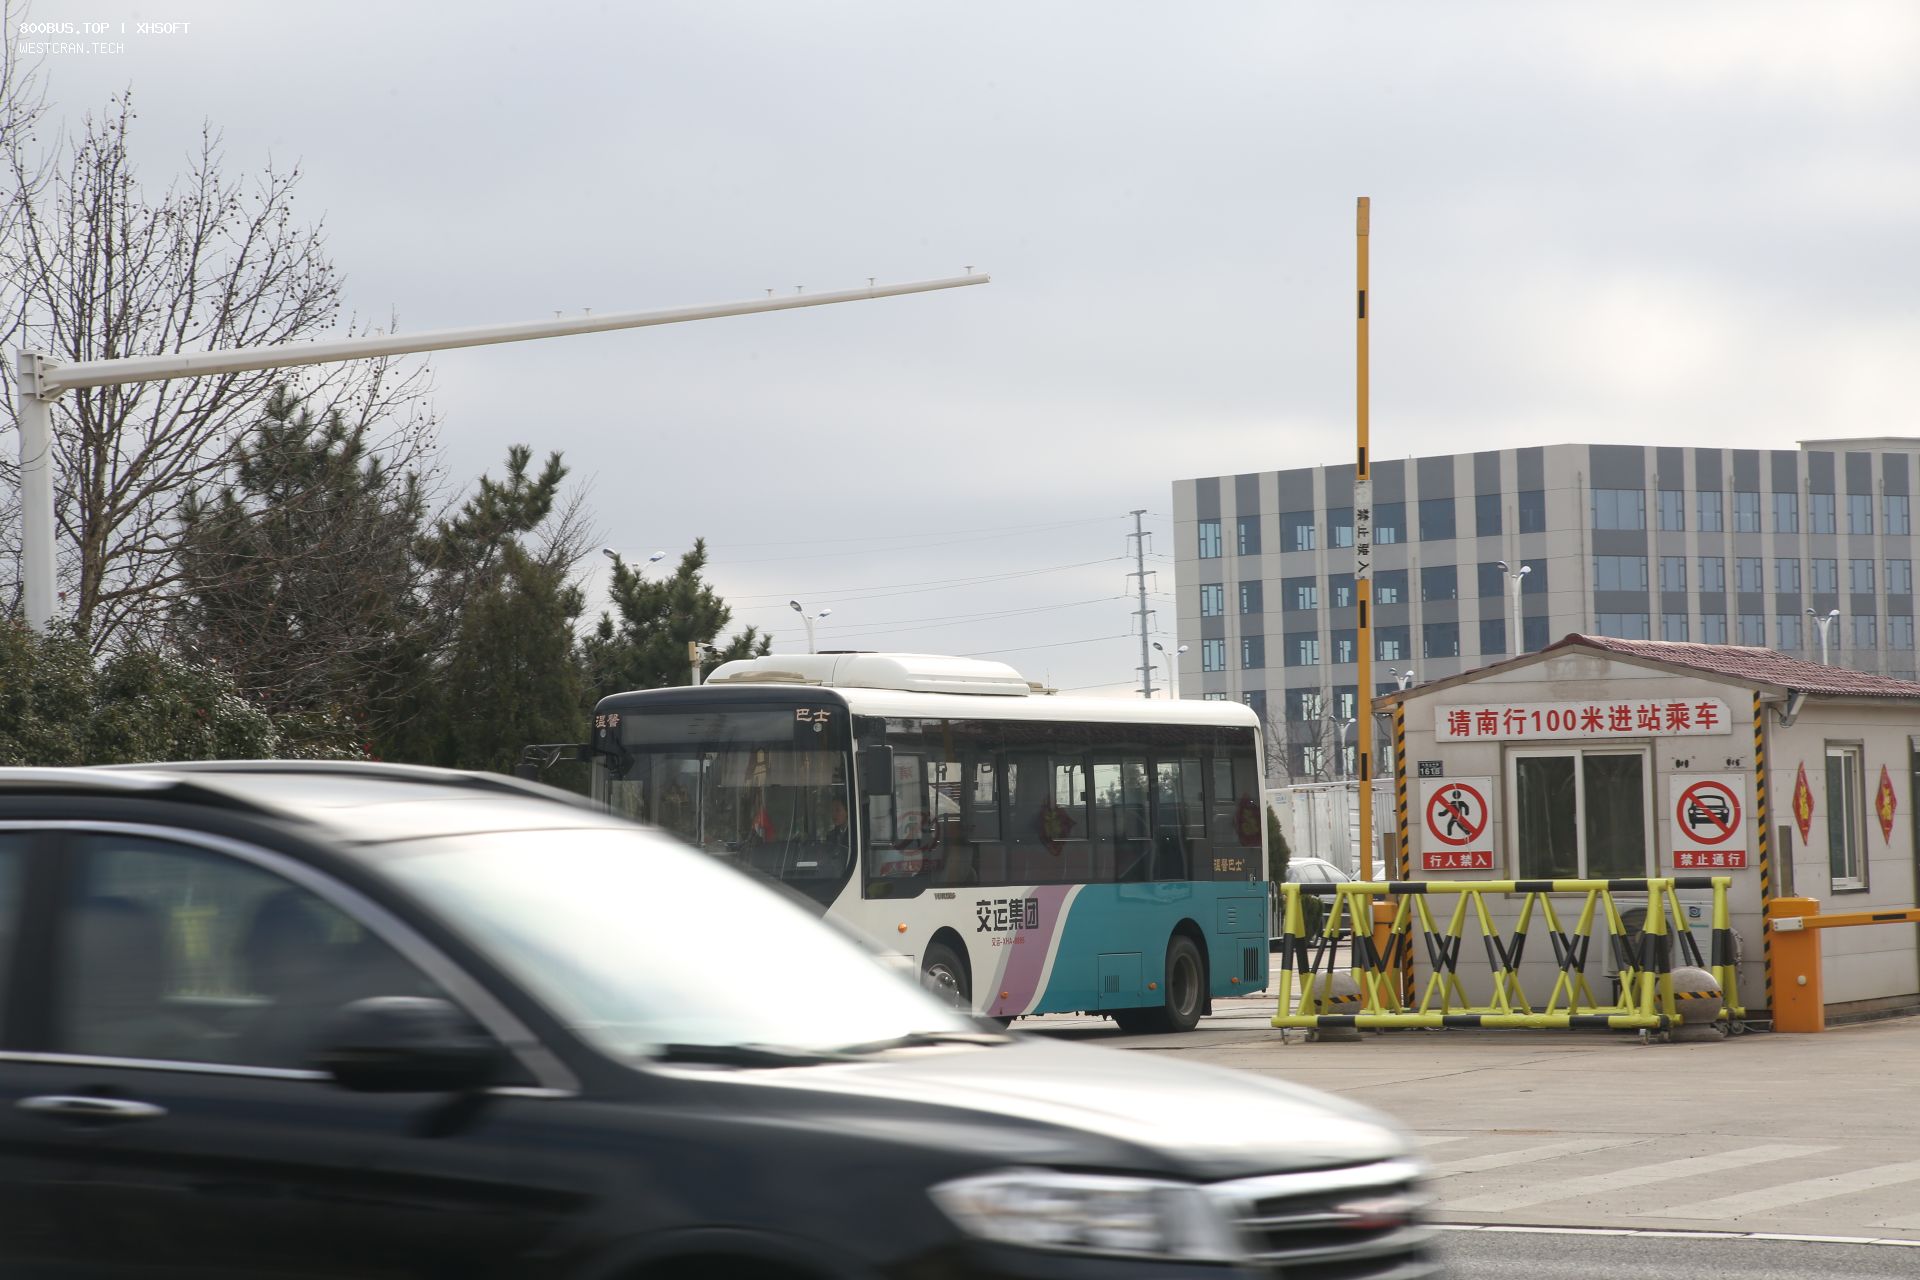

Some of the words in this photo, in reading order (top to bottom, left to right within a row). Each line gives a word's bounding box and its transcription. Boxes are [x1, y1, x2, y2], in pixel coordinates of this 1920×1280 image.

[1356, 508, 1370, 573] 禁止驶入
[796, 708, 831, 723] 巴士
[1447, 702, 1720, 737] 请南行100米进站乘车
[1429, 854, 1488, 868] 行人禁入
[1680, 853, 1741, 866] 禁止通行
[976, 898, 1039, 932] 交运集团
